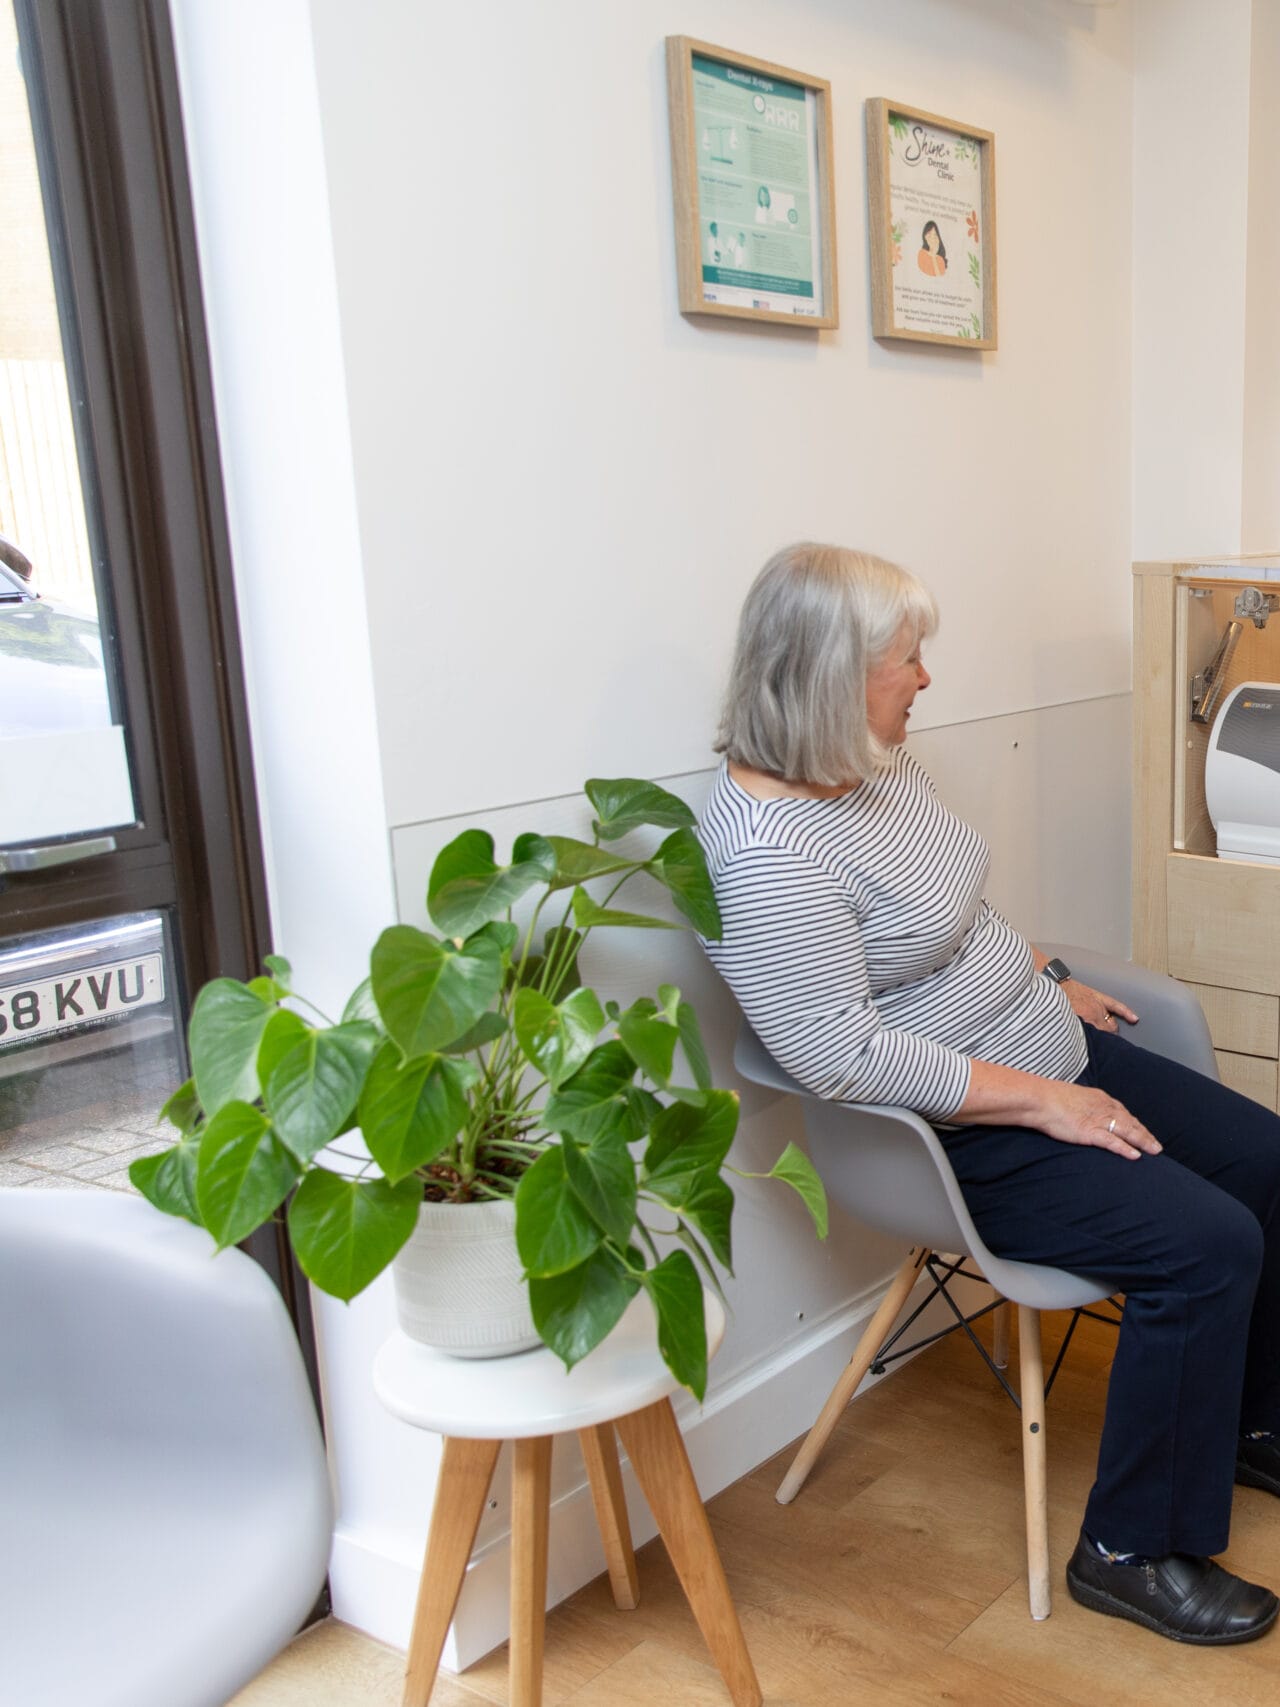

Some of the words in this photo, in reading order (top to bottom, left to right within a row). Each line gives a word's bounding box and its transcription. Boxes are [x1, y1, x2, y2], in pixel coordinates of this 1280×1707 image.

[727, 69, 752, 85] Dental
[905, 126, 946, 161] Shine
[928, 158, 949, 170] Dental
[938, 170, 955, 182] Clinic
[0, 990, 40, 1036] 8
[55, 965, 144, 1020] KVU
